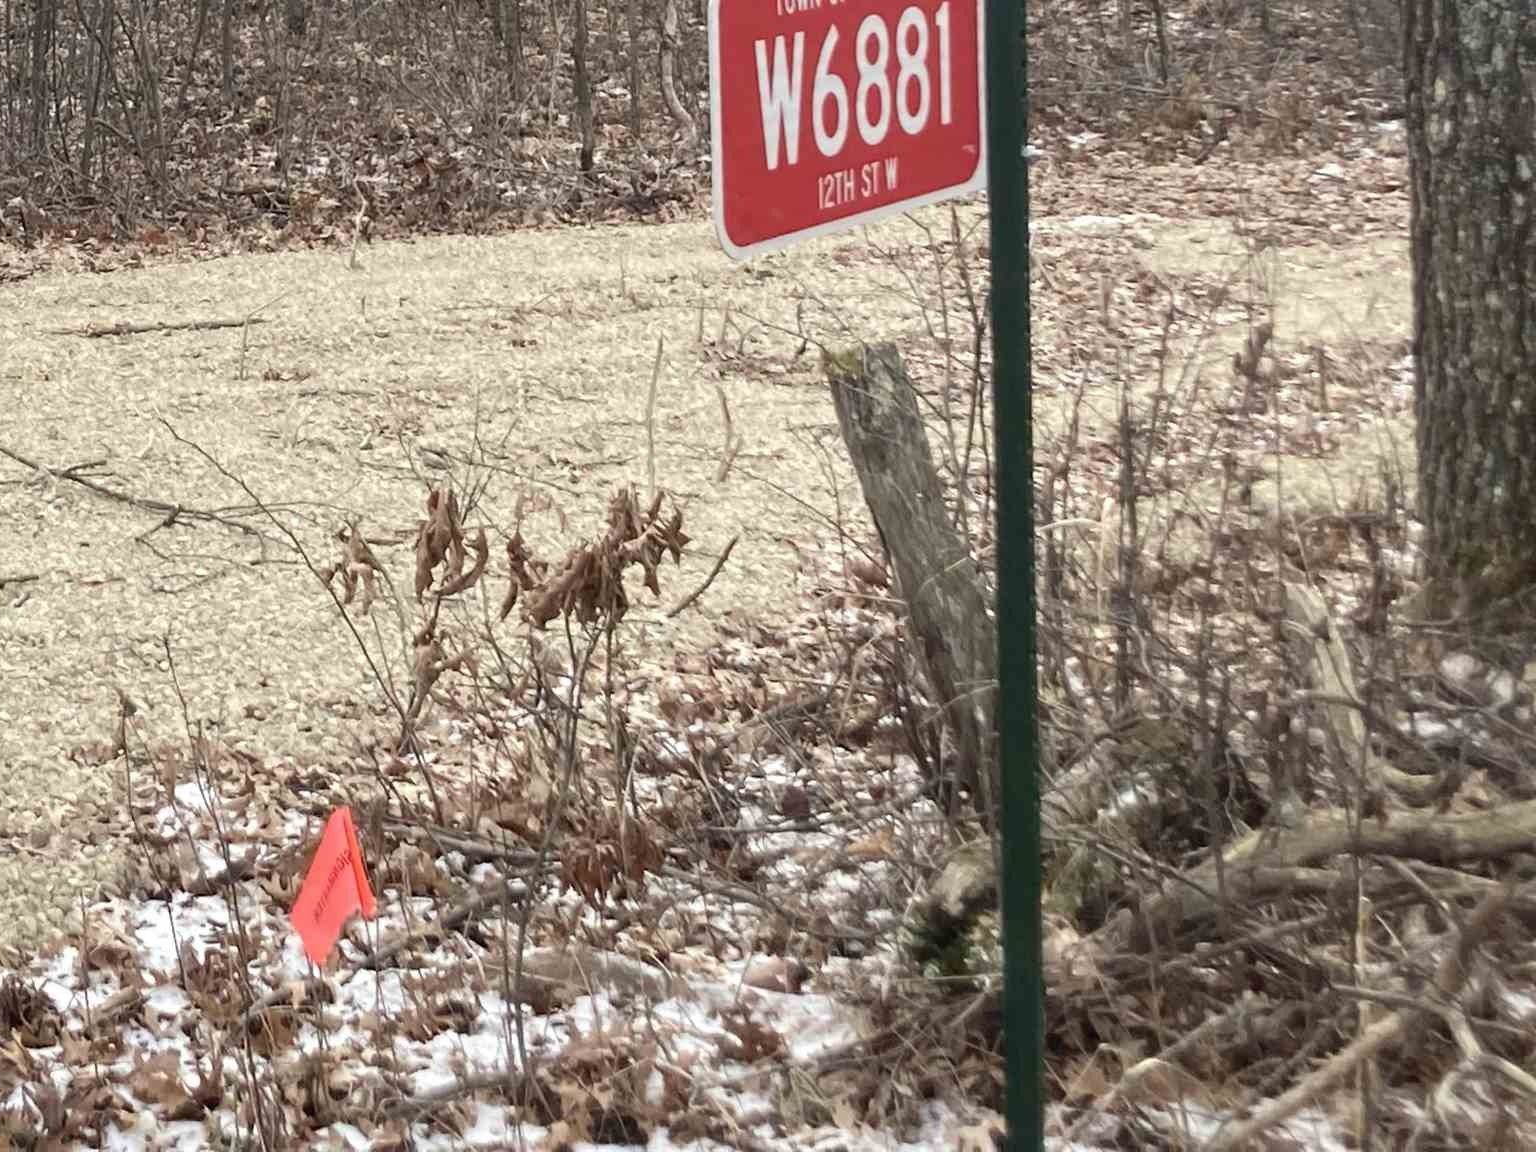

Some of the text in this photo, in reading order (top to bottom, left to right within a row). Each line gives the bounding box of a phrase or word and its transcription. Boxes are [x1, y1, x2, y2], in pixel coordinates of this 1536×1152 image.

[754, 1, 952, 171] W6881
[818, 156, 898, 210] 12TH ST W
